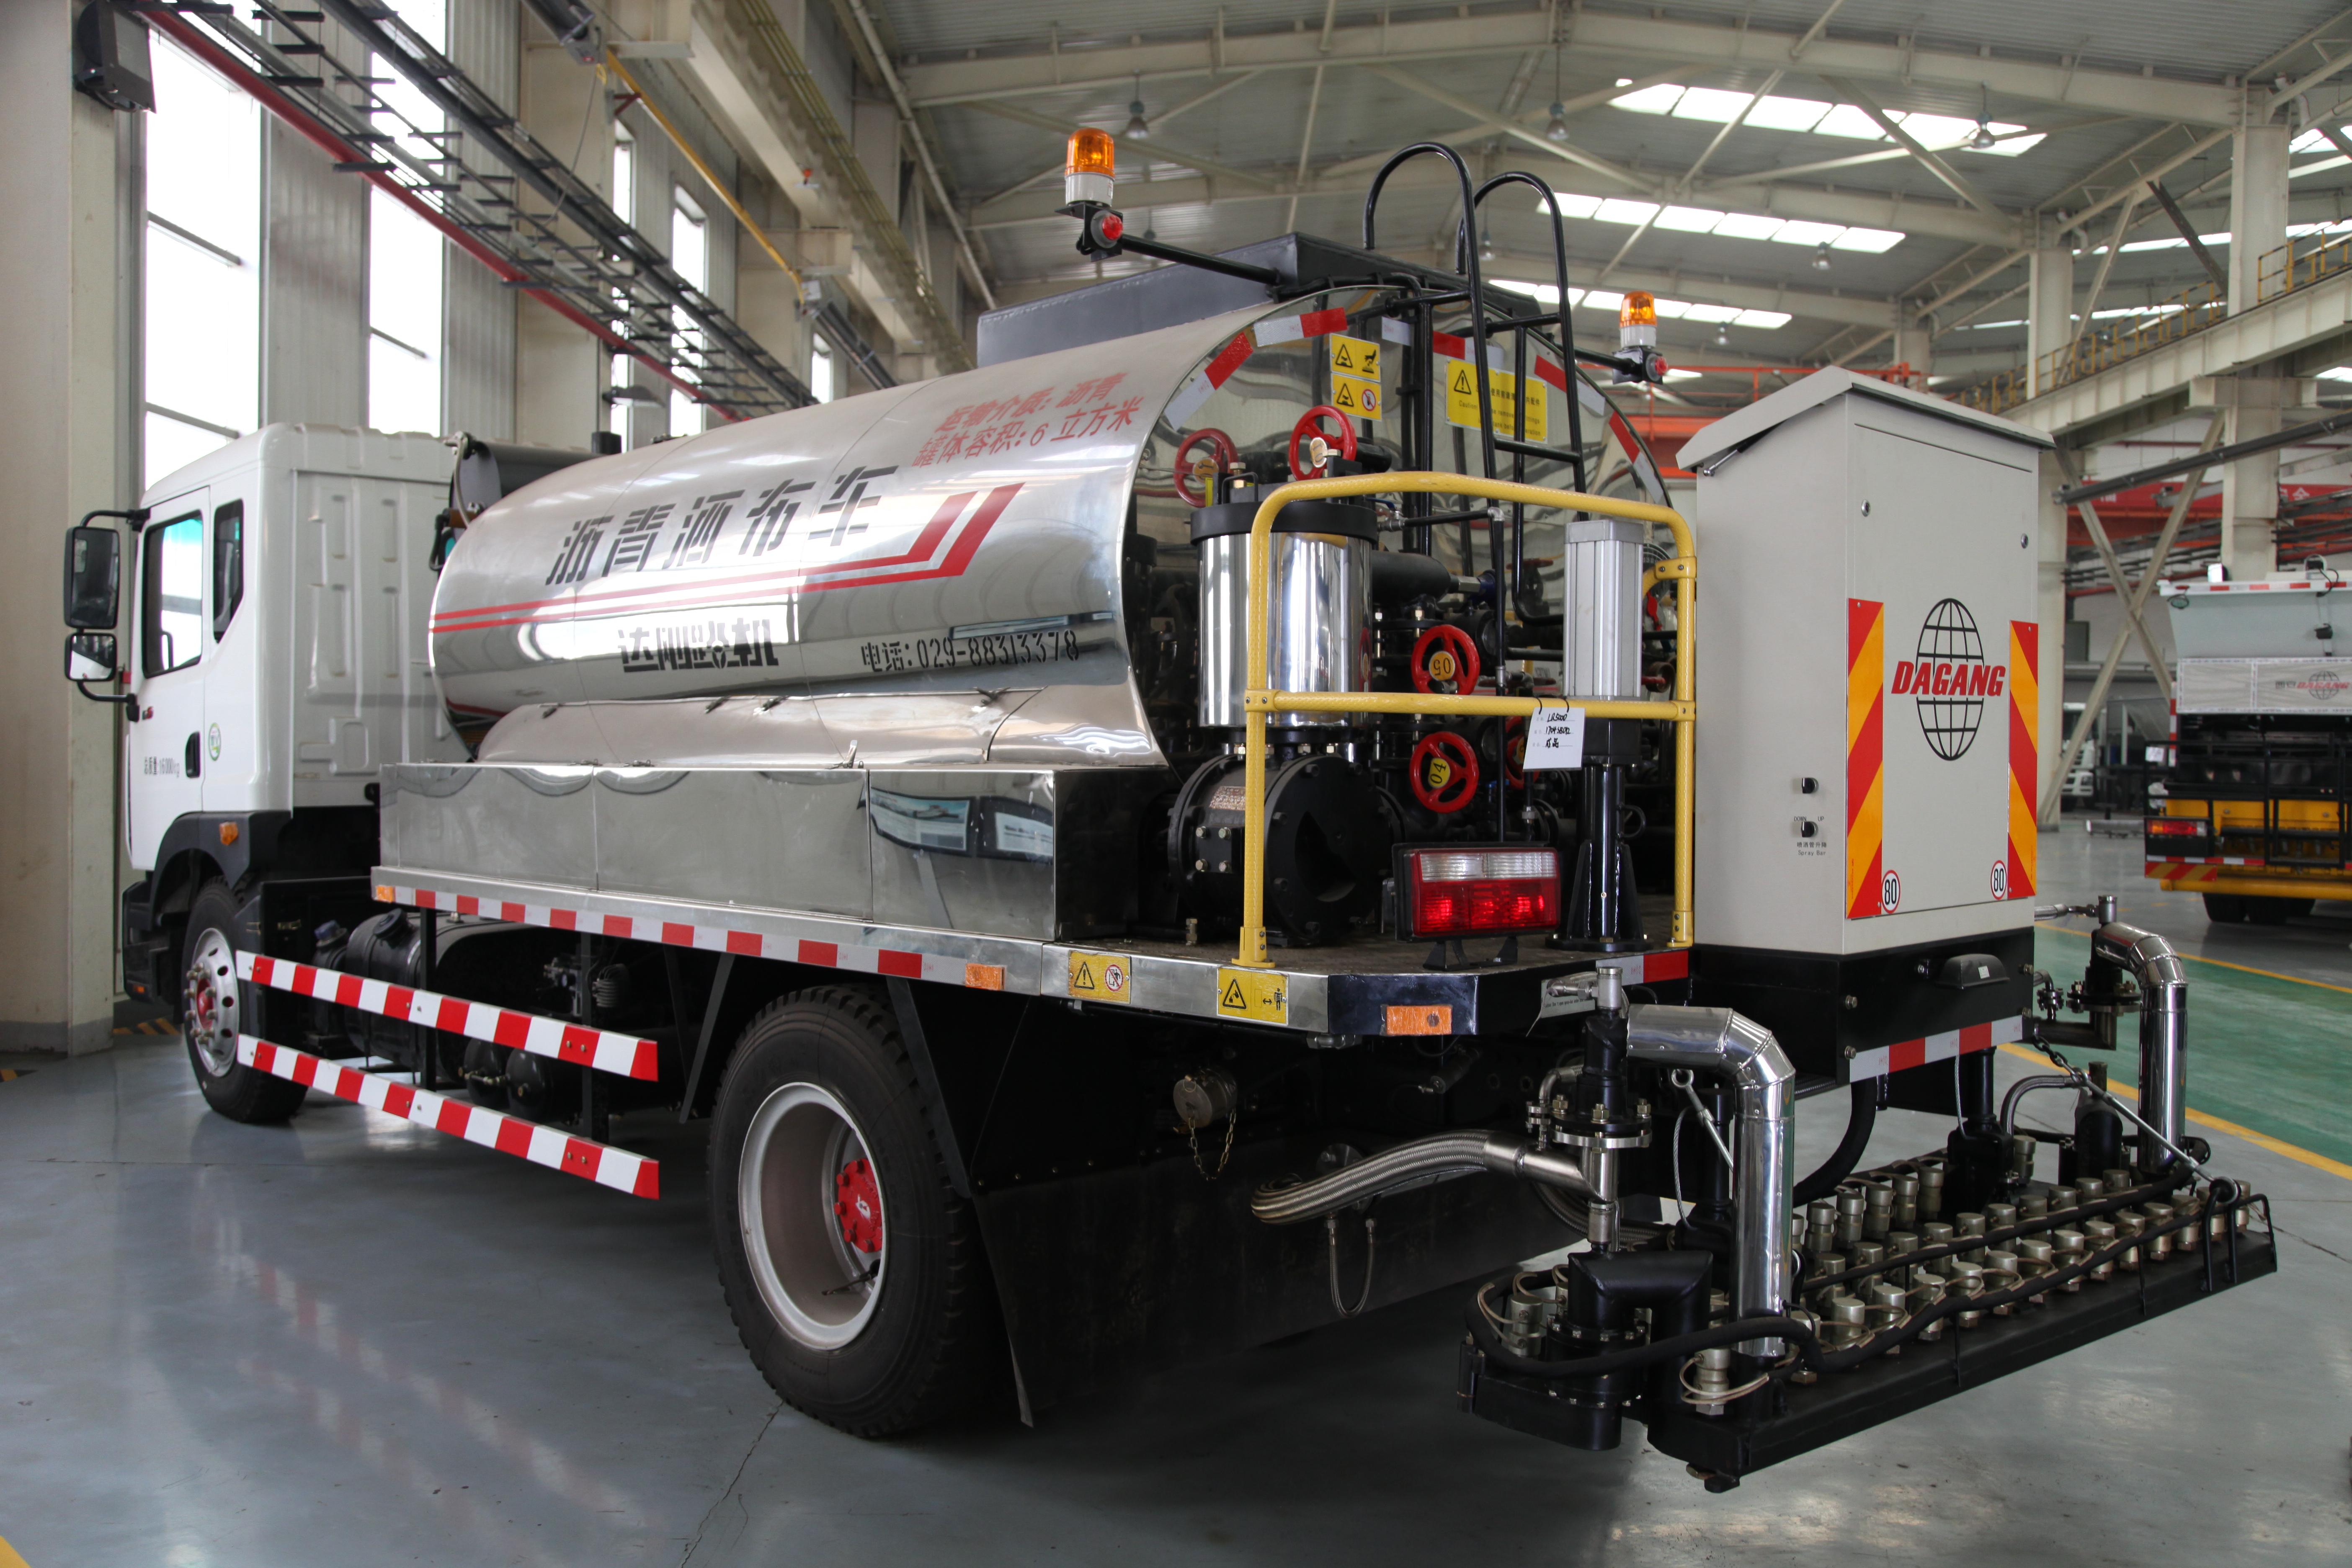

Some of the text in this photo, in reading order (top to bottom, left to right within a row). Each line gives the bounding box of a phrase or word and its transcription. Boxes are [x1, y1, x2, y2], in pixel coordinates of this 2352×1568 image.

[545, 465, 899, 585] 沥青洒布车
[1891, 661, 2006, 696] DAGANG
[1885, 878, 1897, 905] 80
[1994, 868, 2004, 892] 80
